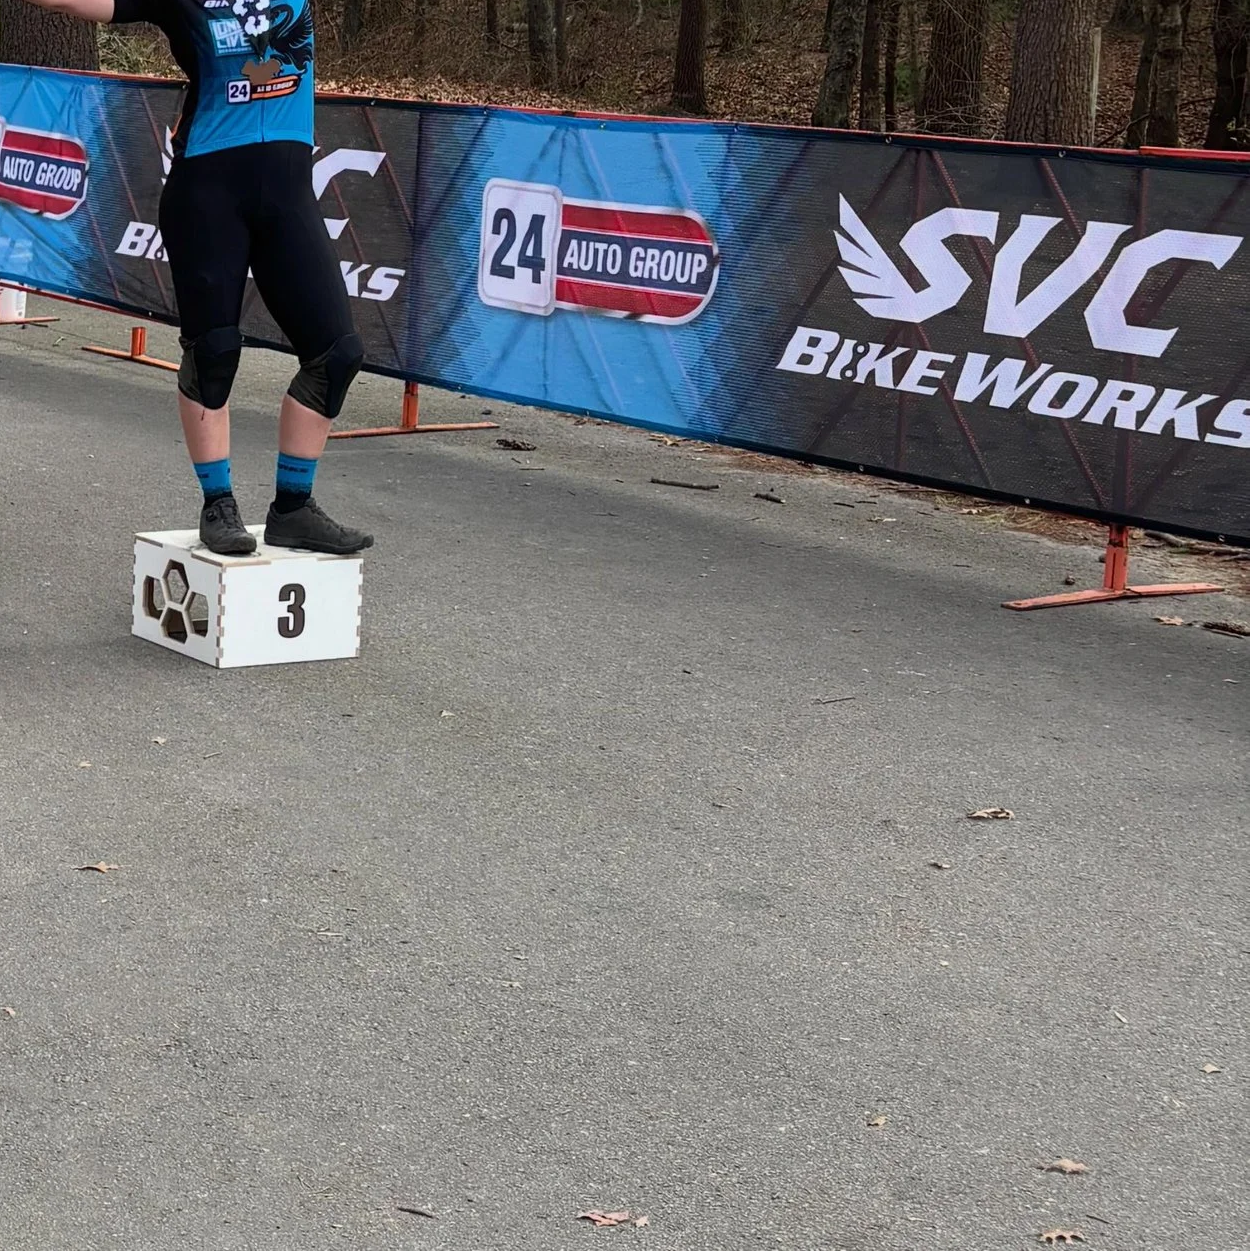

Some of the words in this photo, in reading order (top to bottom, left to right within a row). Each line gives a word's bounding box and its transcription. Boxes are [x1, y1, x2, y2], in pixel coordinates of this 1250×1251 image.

[229, 84, 248, 98] 24
[3, 155, 35, 182] AUTO
[35, 162, 81, 191] GROUP
[489, 207, 546, 285] 24
[563, 238, 622, 276] AUTO
[628, 246, 709, 285] GROUP
[850, 206, 1243, 358] SVC
[277, 583, 306, 639] 3
